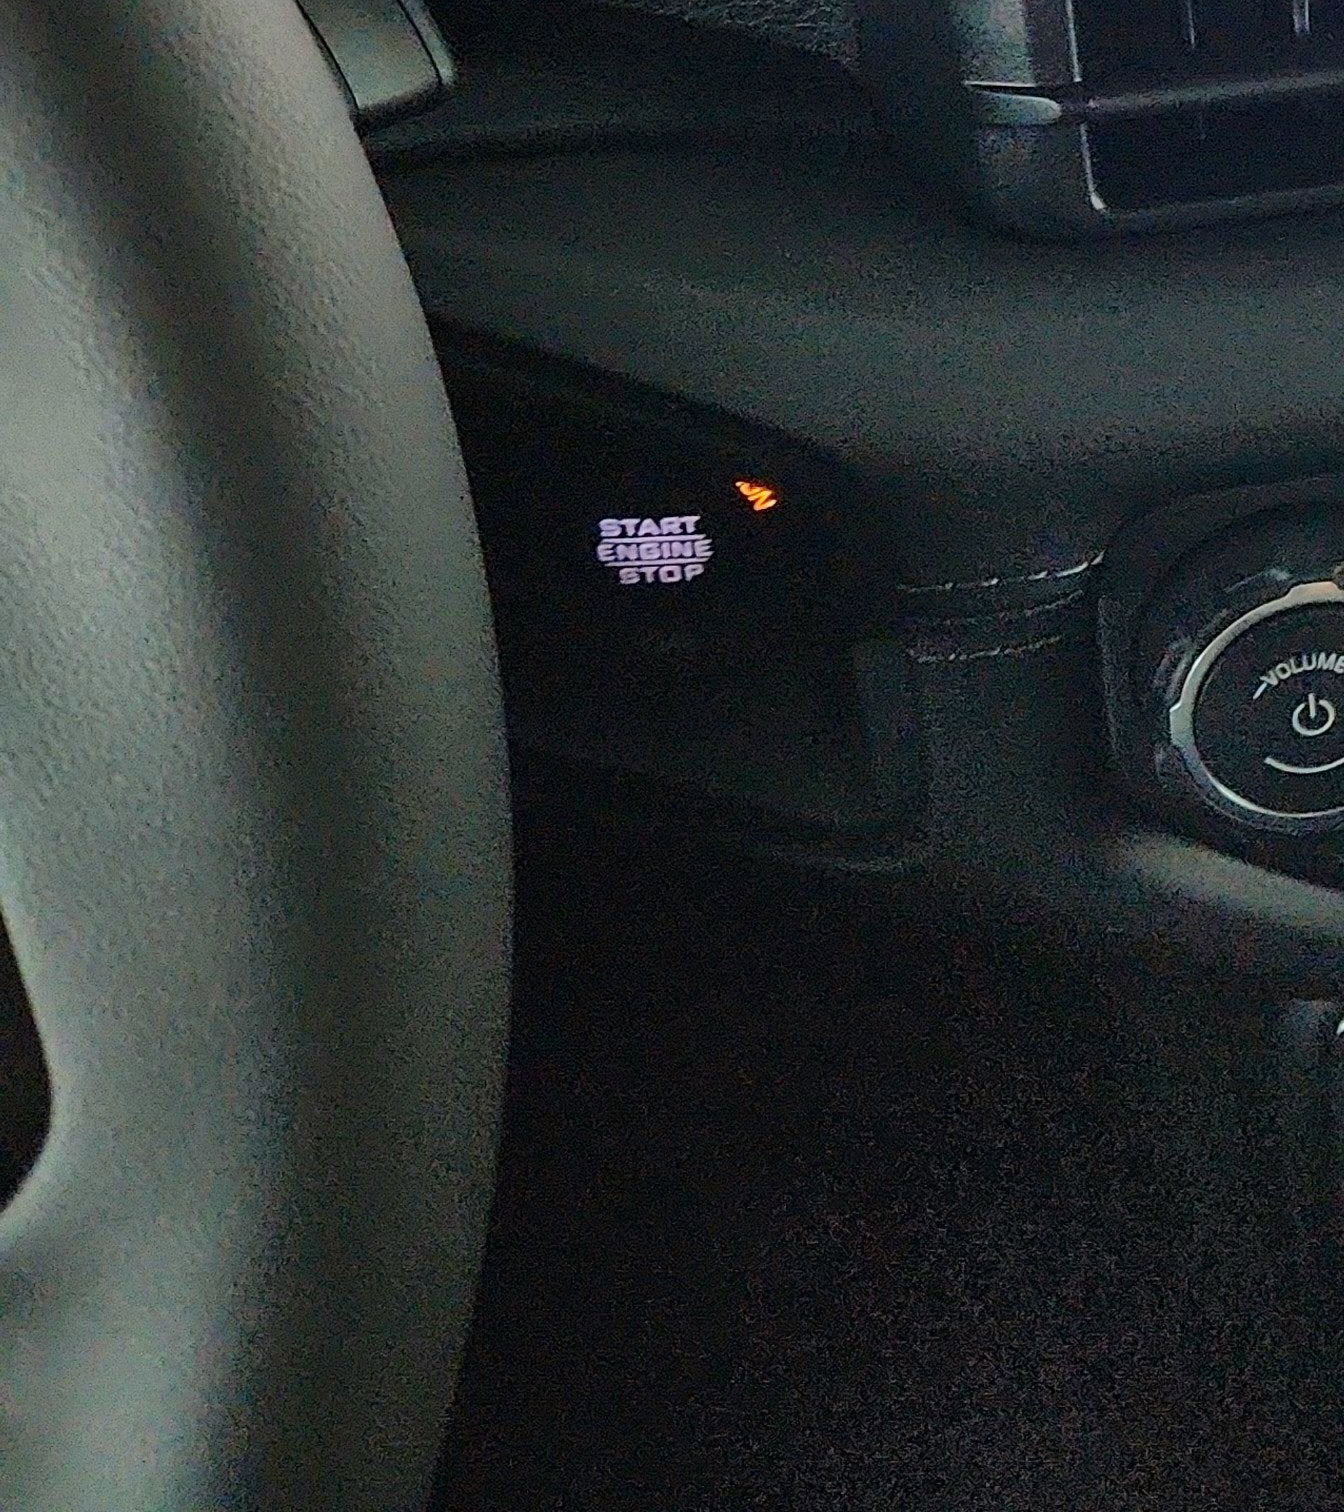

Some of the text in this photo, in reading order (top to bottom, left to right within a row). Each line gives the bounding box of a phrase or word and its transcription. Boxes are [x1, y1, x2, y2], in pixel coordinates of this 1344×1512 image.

[598, 515, 701, 538] START
[596, 538, 715, 562] ENGINE
[619, 563, 705, 585] STOP
